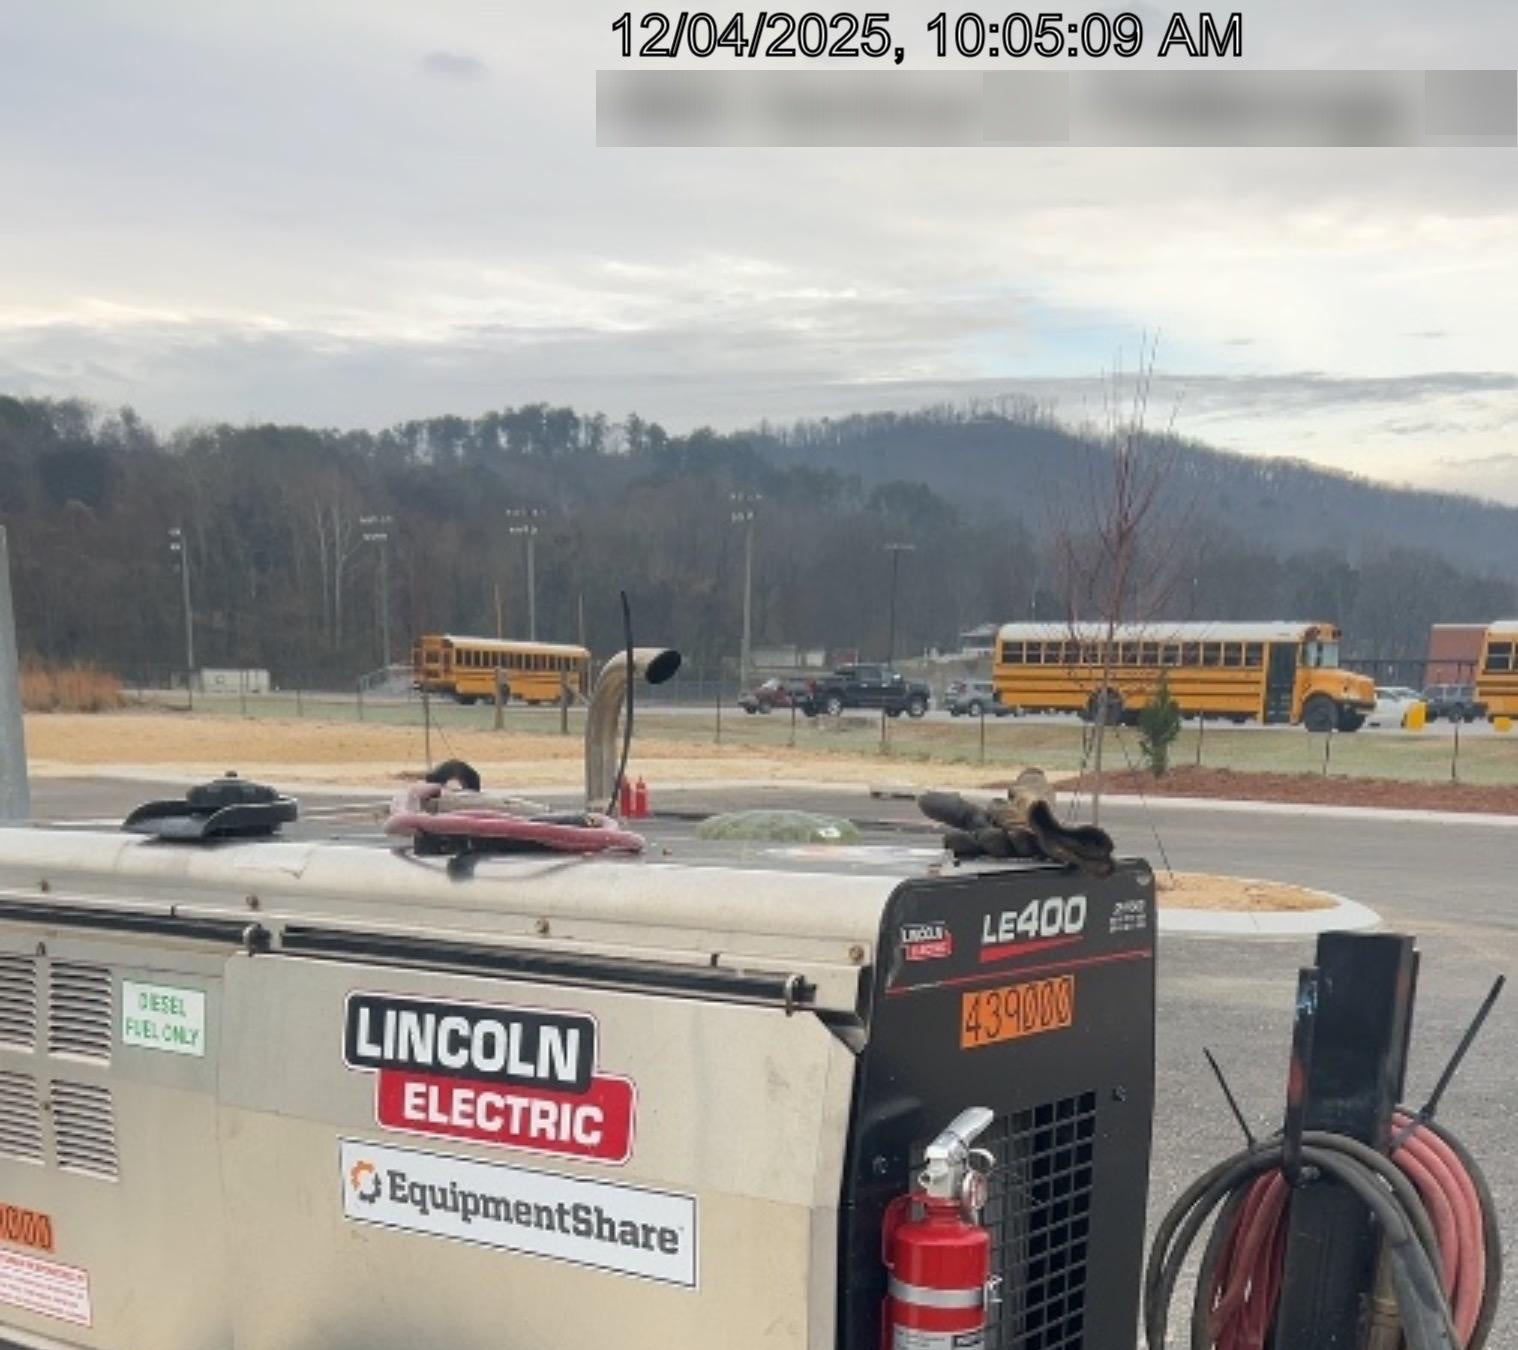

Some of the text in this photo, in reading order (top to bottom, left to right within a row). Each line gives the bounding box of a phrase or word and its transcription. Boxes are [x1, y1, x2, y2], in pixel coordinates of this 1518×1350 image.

[981, 896, 1087, 944] LE400
[126, 1017, 199, 1047] FUEL ONLY
[139, 992, 186, 1018] DIESEL
[964, 978, 1072, 1041] 439000
[355, 1006, 581, 1083] LINCOLN
[403, 1081, 604, 1147] ELECTRIC
[387, 1169, 680, 1256] EquipmentShare
